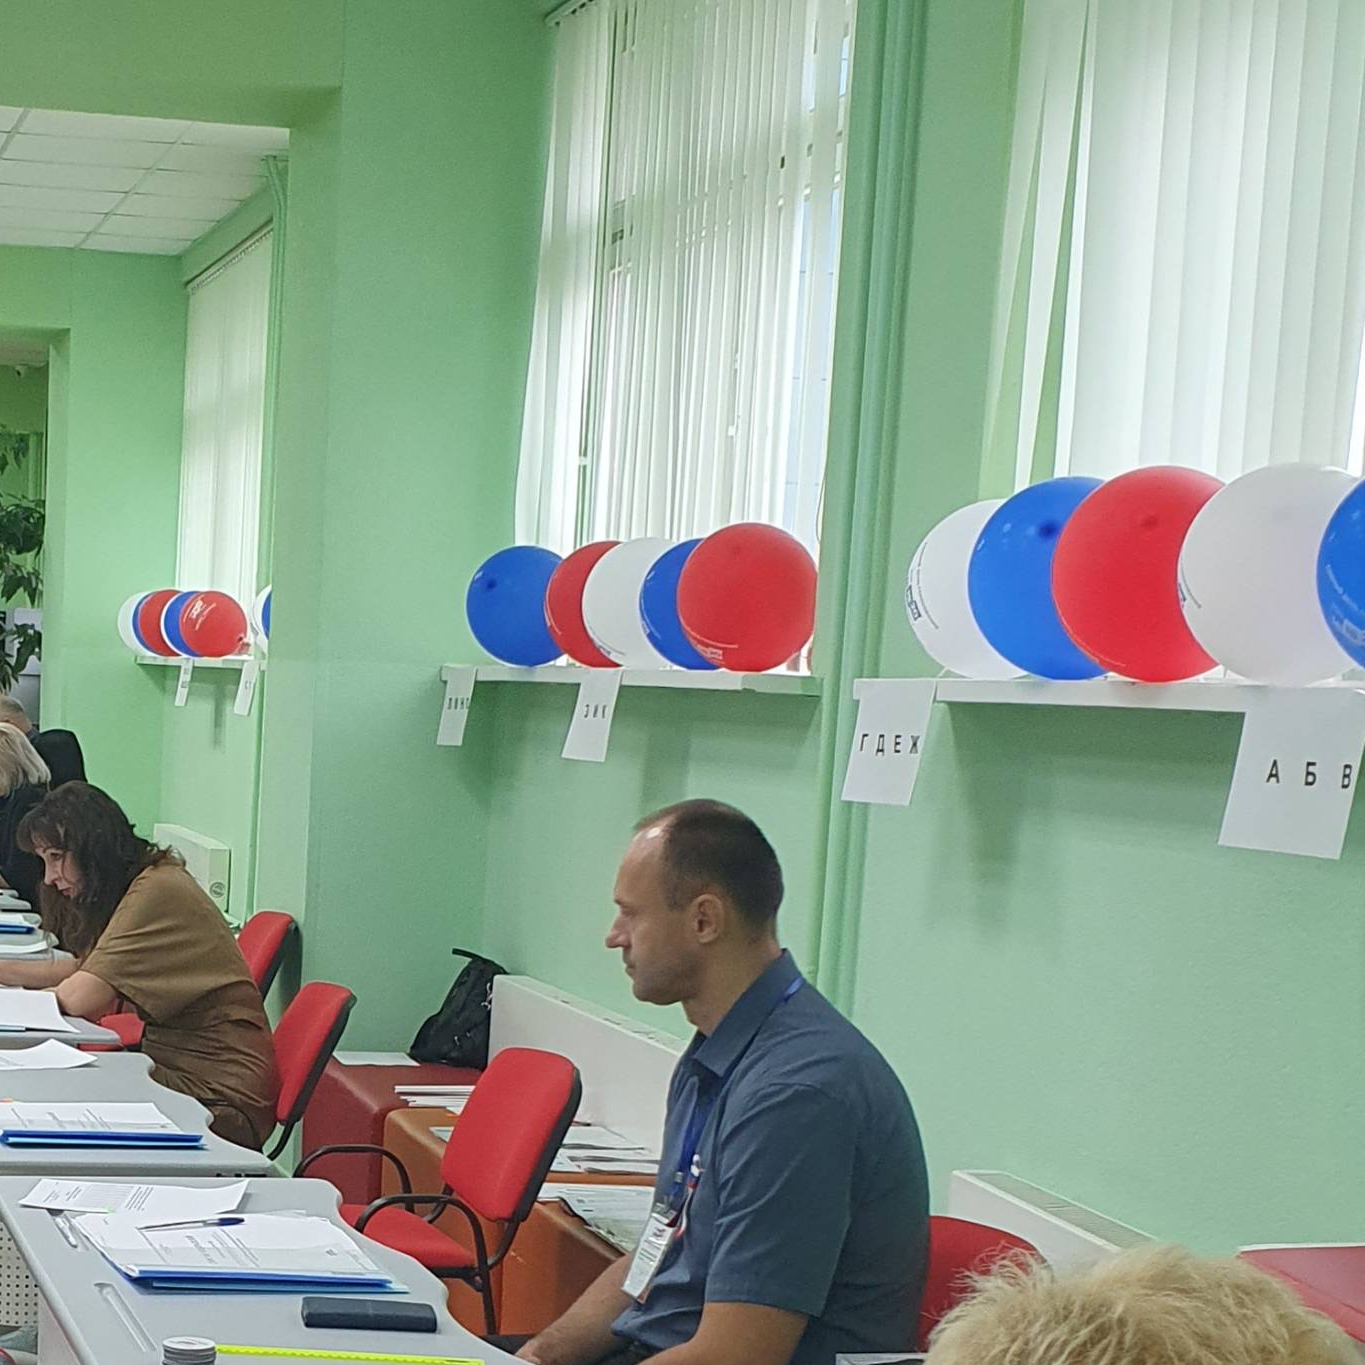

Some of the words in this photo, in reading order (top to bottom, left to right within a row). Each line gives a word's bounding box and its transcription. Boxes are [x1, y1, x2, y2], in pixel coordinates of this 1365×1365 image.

[859, 733, 869, 751] Г
[875, 734, 885, 756] Д
[894, 734, 902, 753] Е
[1266, 758, 1280, 784] А
[1303, 761, 1317, 787] Б
[1341, 763, 1353, 790] В
